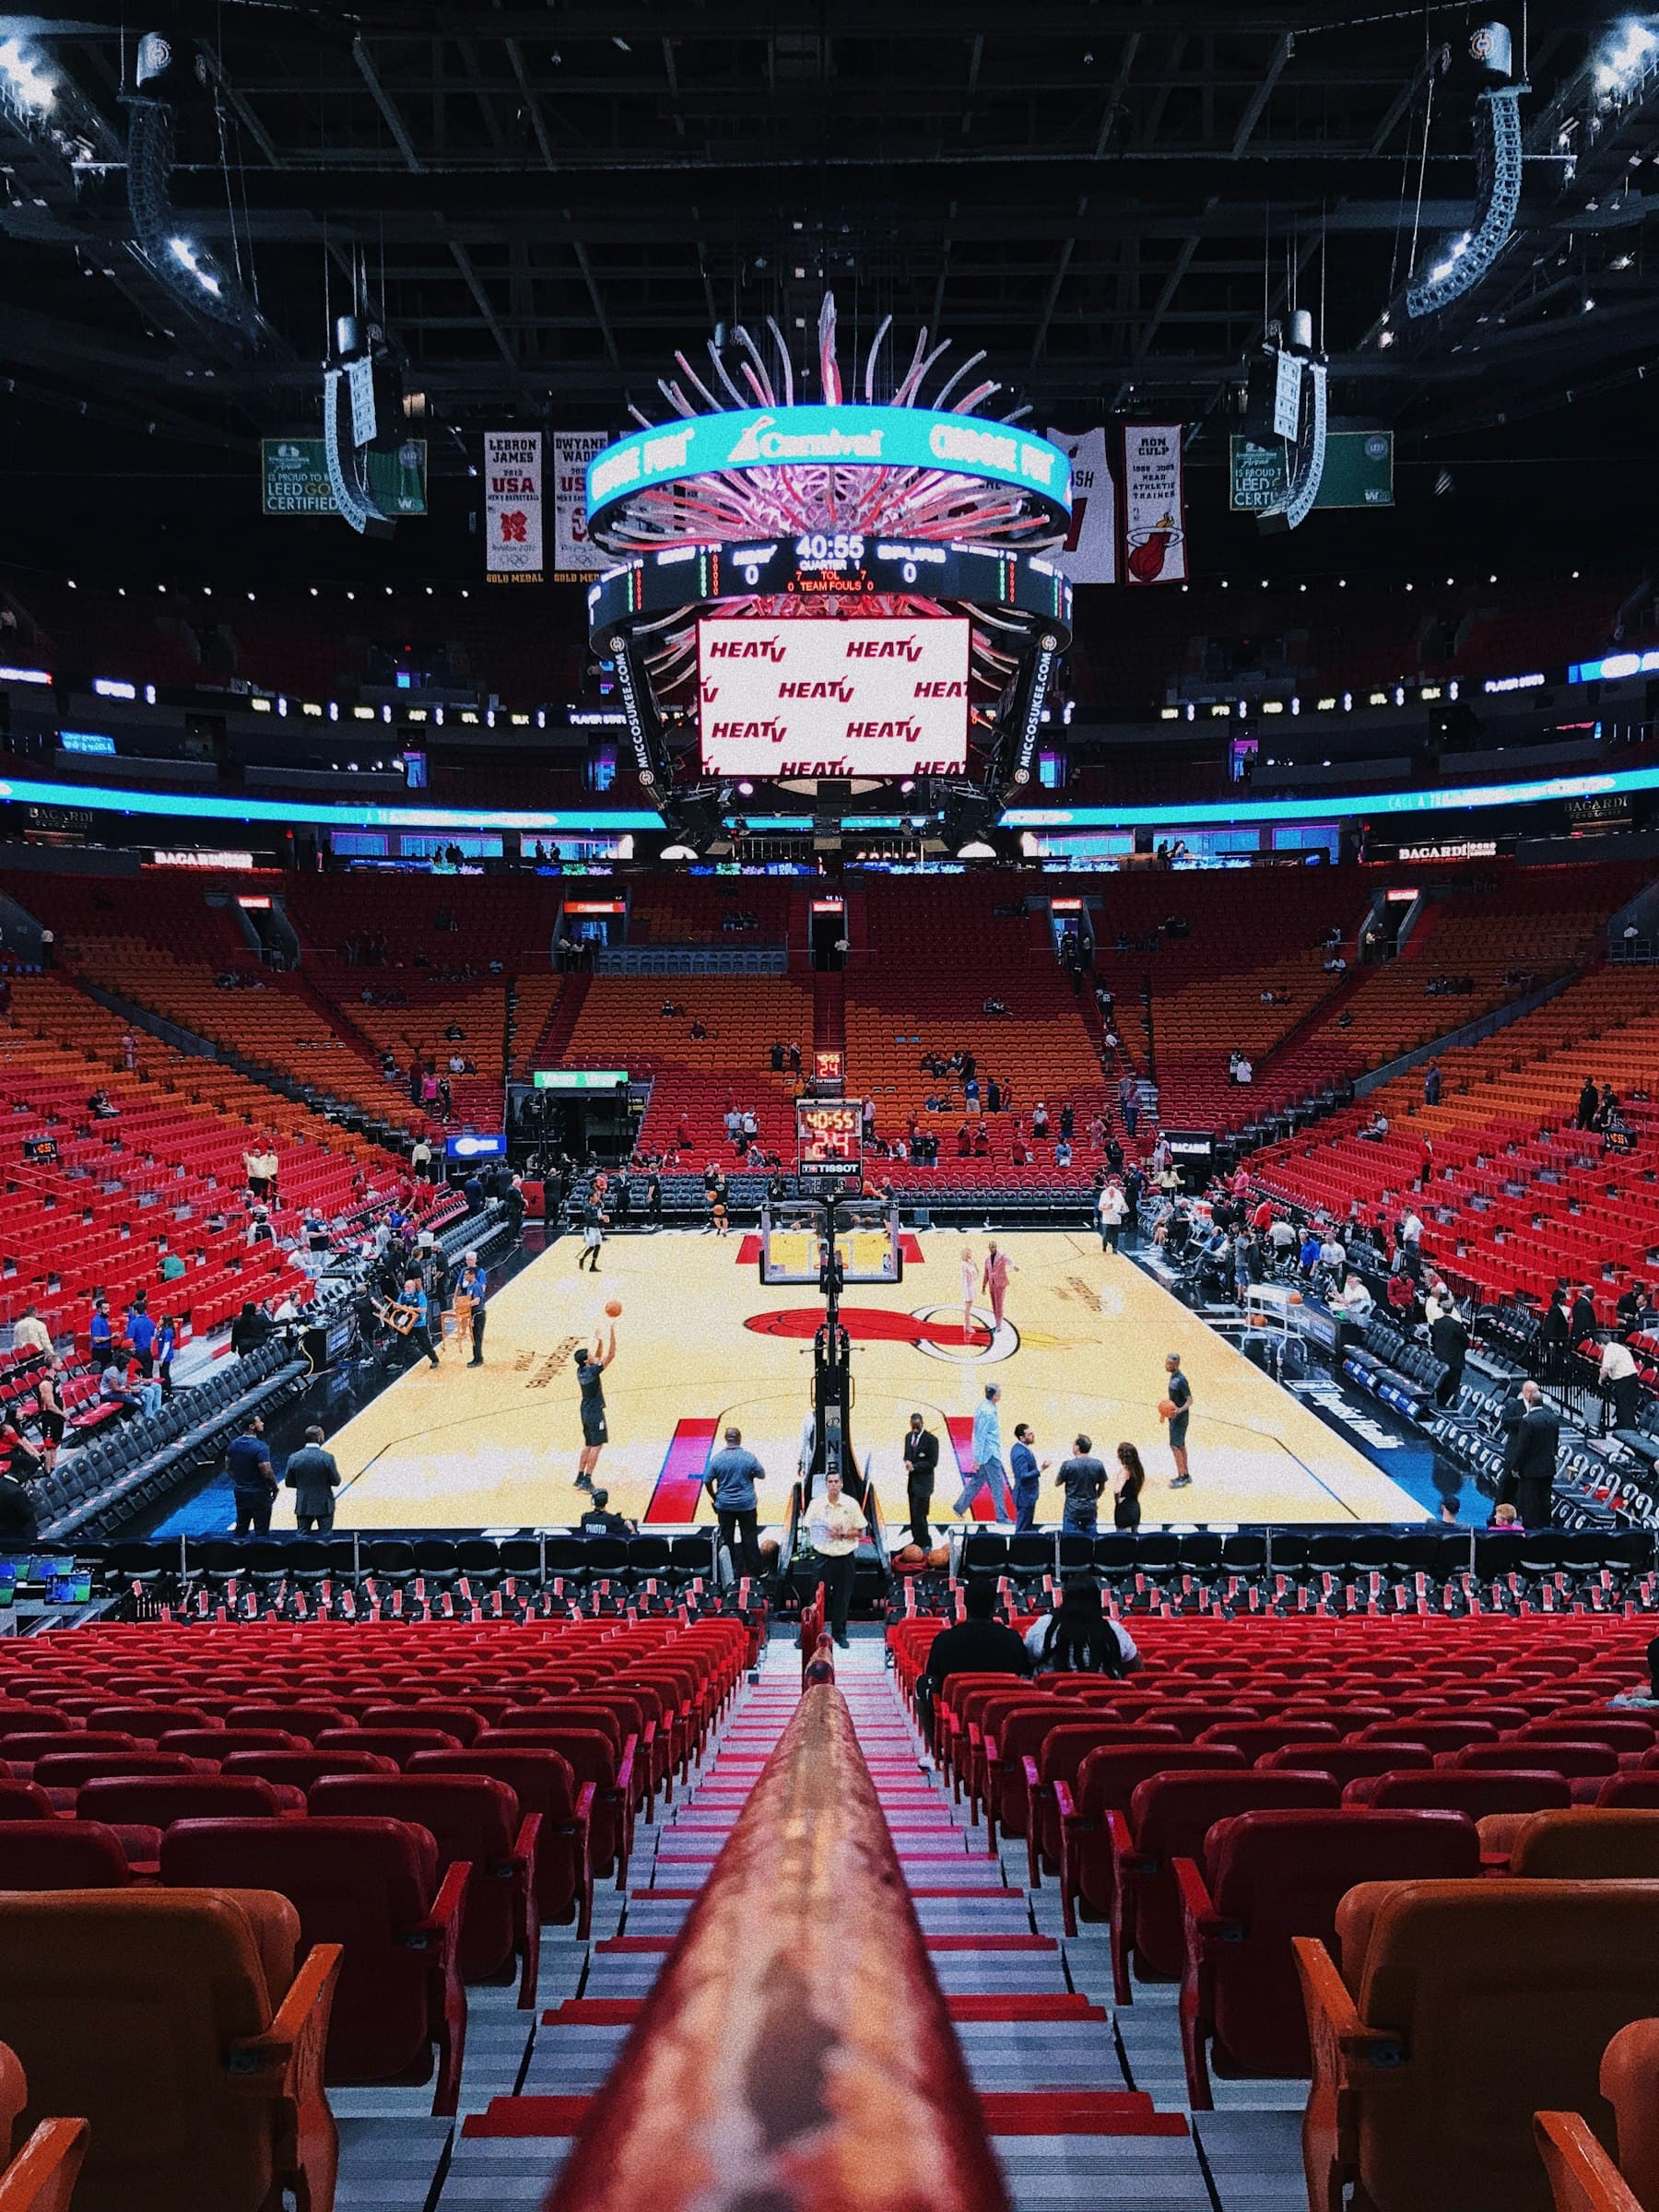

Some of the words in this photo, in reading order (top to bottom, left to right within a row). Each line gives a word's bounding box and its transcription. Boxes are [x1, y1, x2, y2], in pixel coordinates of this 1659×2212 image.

[488, 439, 536, 451] LEBRON
[1141, 438, 1166, 447] RON
[1138, 446, 1170, 456] CULP
[492, 452, 534, 464] JAMES
[278, 473, 308, 482] PROUD
[268, 484, 302, 496] LEED
[491, 477, 535, 493] USA
[560, 477, 587, 493] US
[1235, 479, 1269, 491] LEED
[1133, 490, 1175, 500] TRAINER
[267, 498, 338, 510] CERTIFIED
[795, 535, 865, 559] 40:55
[799, 559, 847, 571] QUARTER
[745, 564, 759, 585] 0
[795, 571, 803, 581] 7
[820, 571, 840, 581] TOL
[861, 571, 868, 581] 7
[903, 561, 917, 583] 0
[787, 582, 794, 592] 0
[799, 582, 828, 592] TEAM
[830, 581, 862, 592] FOULS
[866, 581, 874, 591] 0
[615, 653, 649, 769] MICCOSUKEE.COM
[1019, 652, 1053, 769] MICCOSUKEE.COM
[819, 1063, 838, 1077] 24
[806, 1111, 854, 1130] 40:55
[812, 1130, 849, 1159] 24
[818, 1164, 859, 1173] TISSOT
[585, 1524, 606, 1534] PHOTO
